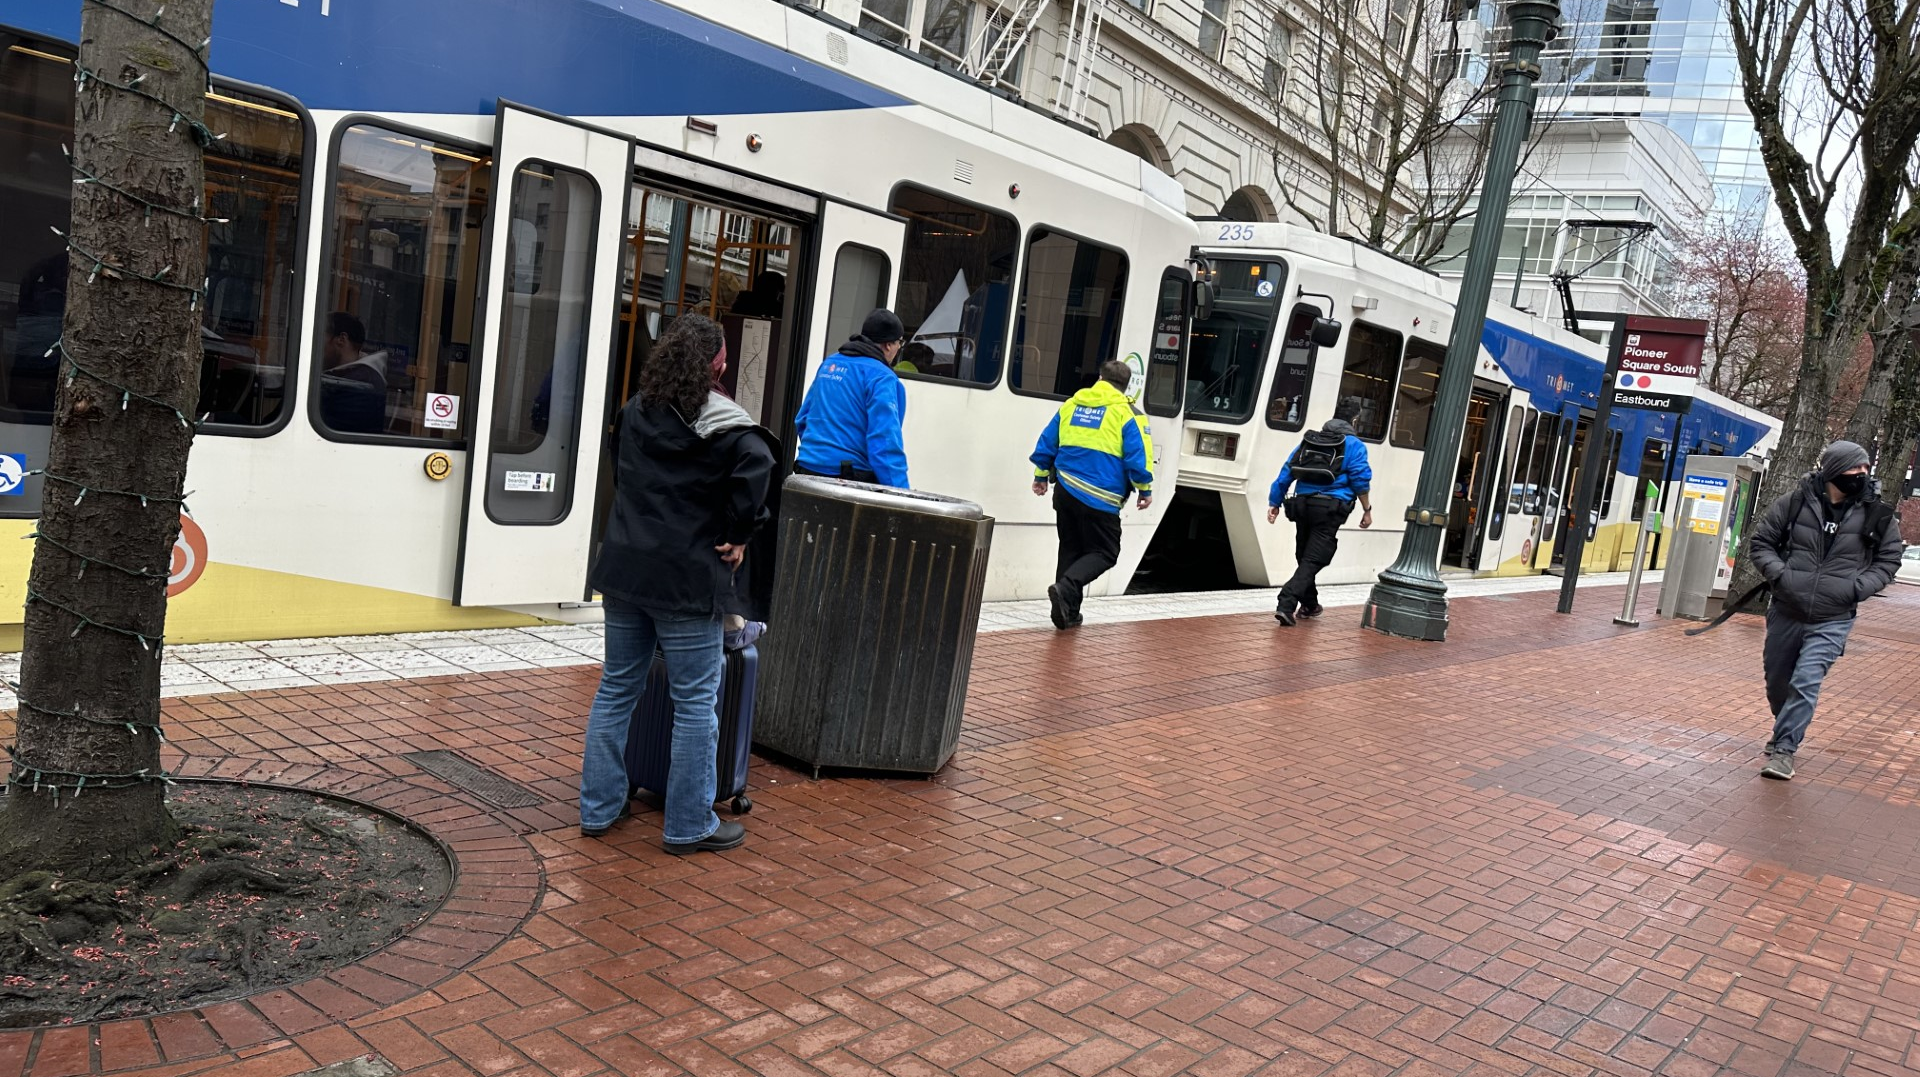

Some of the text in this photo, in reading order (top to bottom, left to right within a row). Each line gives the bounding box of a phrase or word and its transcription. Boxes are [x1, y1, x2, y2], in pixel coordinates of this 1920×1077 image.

[1218, 224, 1255, 241] 235
[1624, 346, 1669, 359] Pioneer
[1622, 359, 1697, 375] Square South
[1614, 392, 1671, 408] Eastbound
